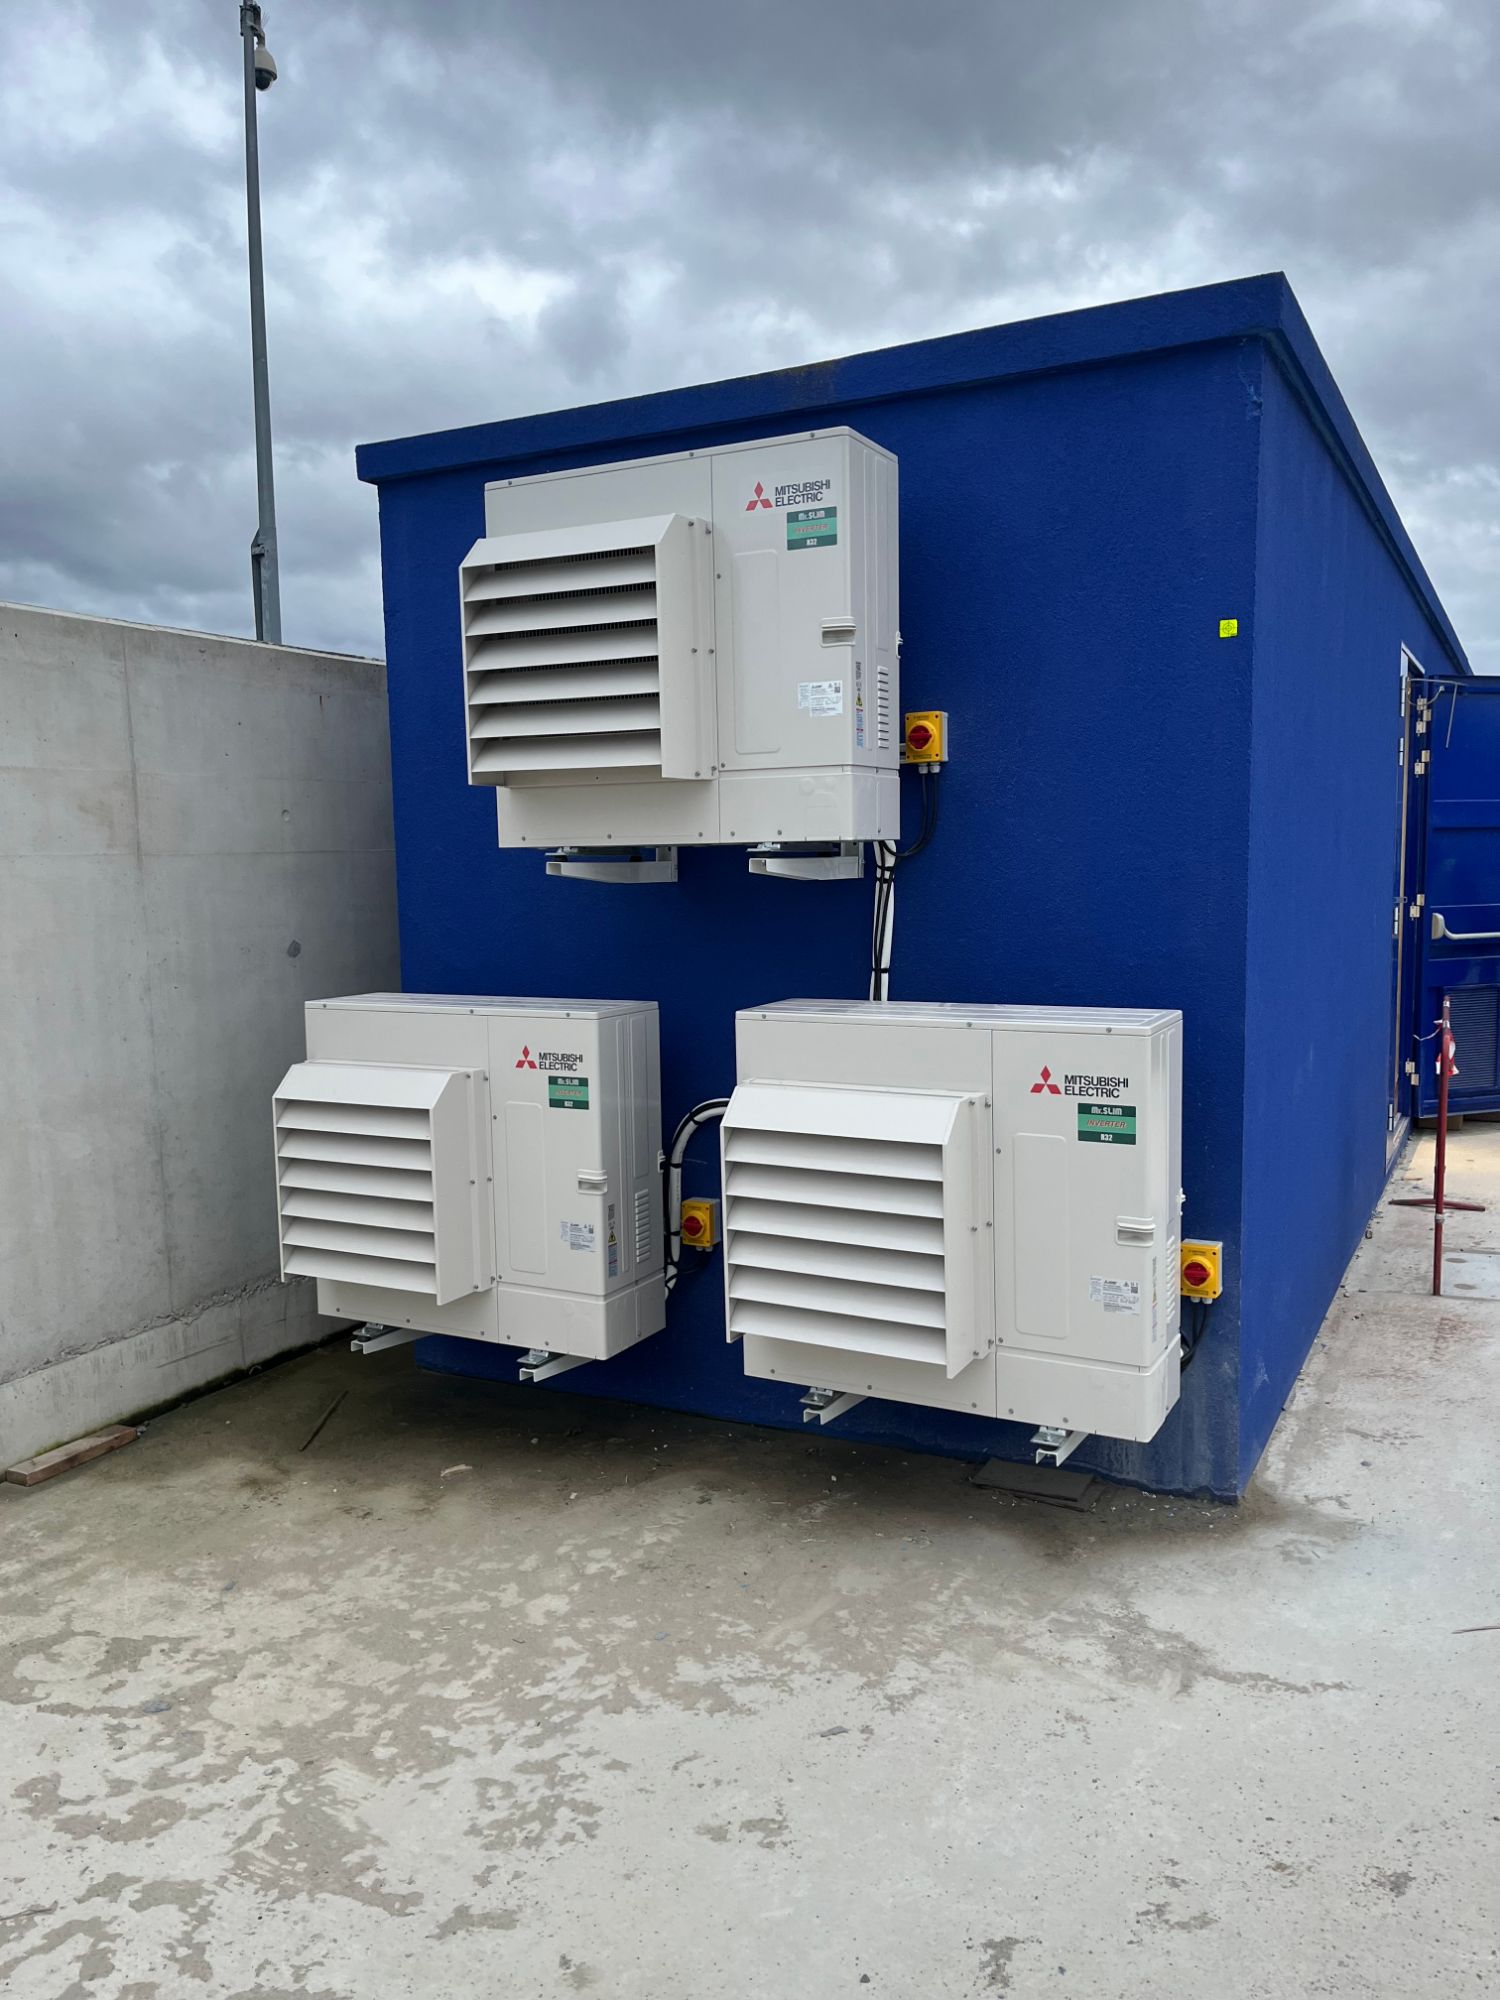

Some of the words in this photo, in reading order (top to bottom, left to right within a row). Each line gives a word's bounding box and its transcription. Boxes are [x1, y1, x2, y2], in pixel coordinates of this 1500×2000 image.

[775, 479, 831, 496] MITSUBISHI
[775, 491, 823, 507] ELECTRIC
[538, 1052, 583, 1063] MITSUBISHI
[539, 1061, 578, 1072] ELECTRIC
[1064, 1074, 1129, 1088] MITSUBISHI
[1064, 1086, 1120, 1099] ELECTRIC
[1100, 1133, 1113, 1142] R32
